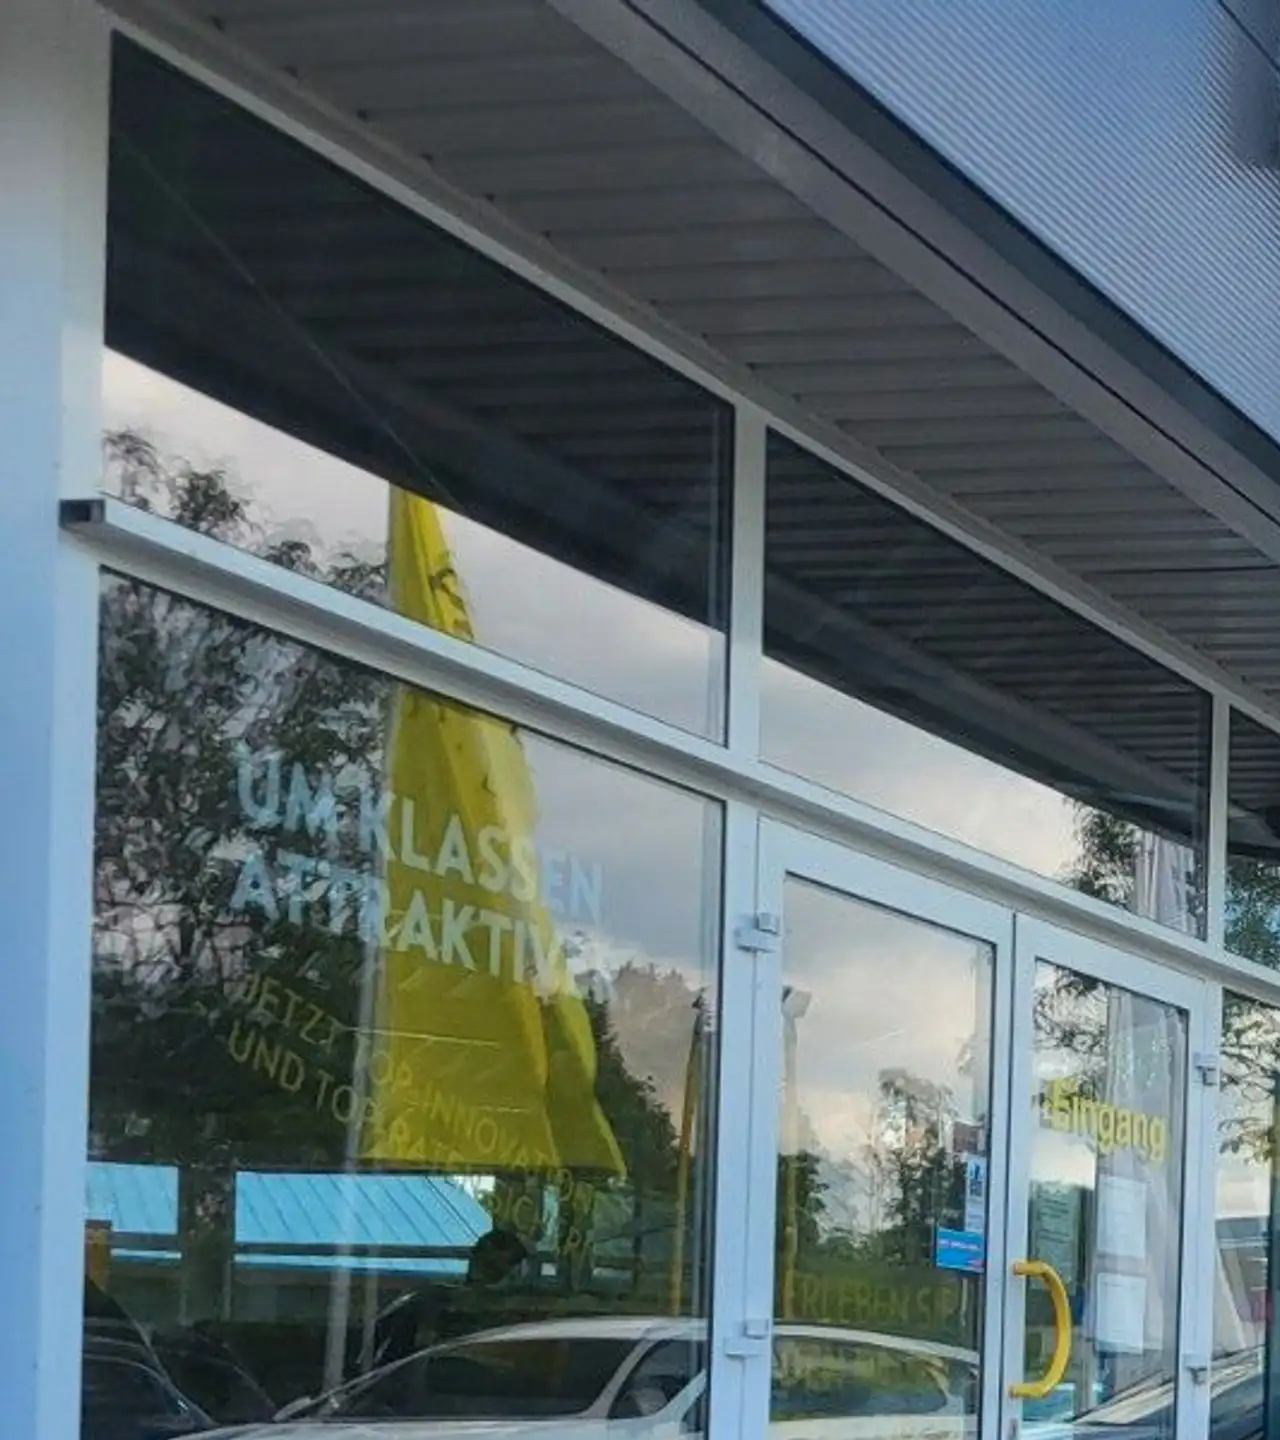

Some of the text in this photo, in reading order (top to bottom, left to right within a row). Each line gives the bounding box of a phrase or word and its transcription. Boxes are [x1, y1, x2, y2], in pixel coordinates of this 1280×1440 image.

[236, 750, 602, 926] UM KLASSEN
[227, 1020, 306, 1092] UND
[1048, 1078, 1168, 1162] Eingang
